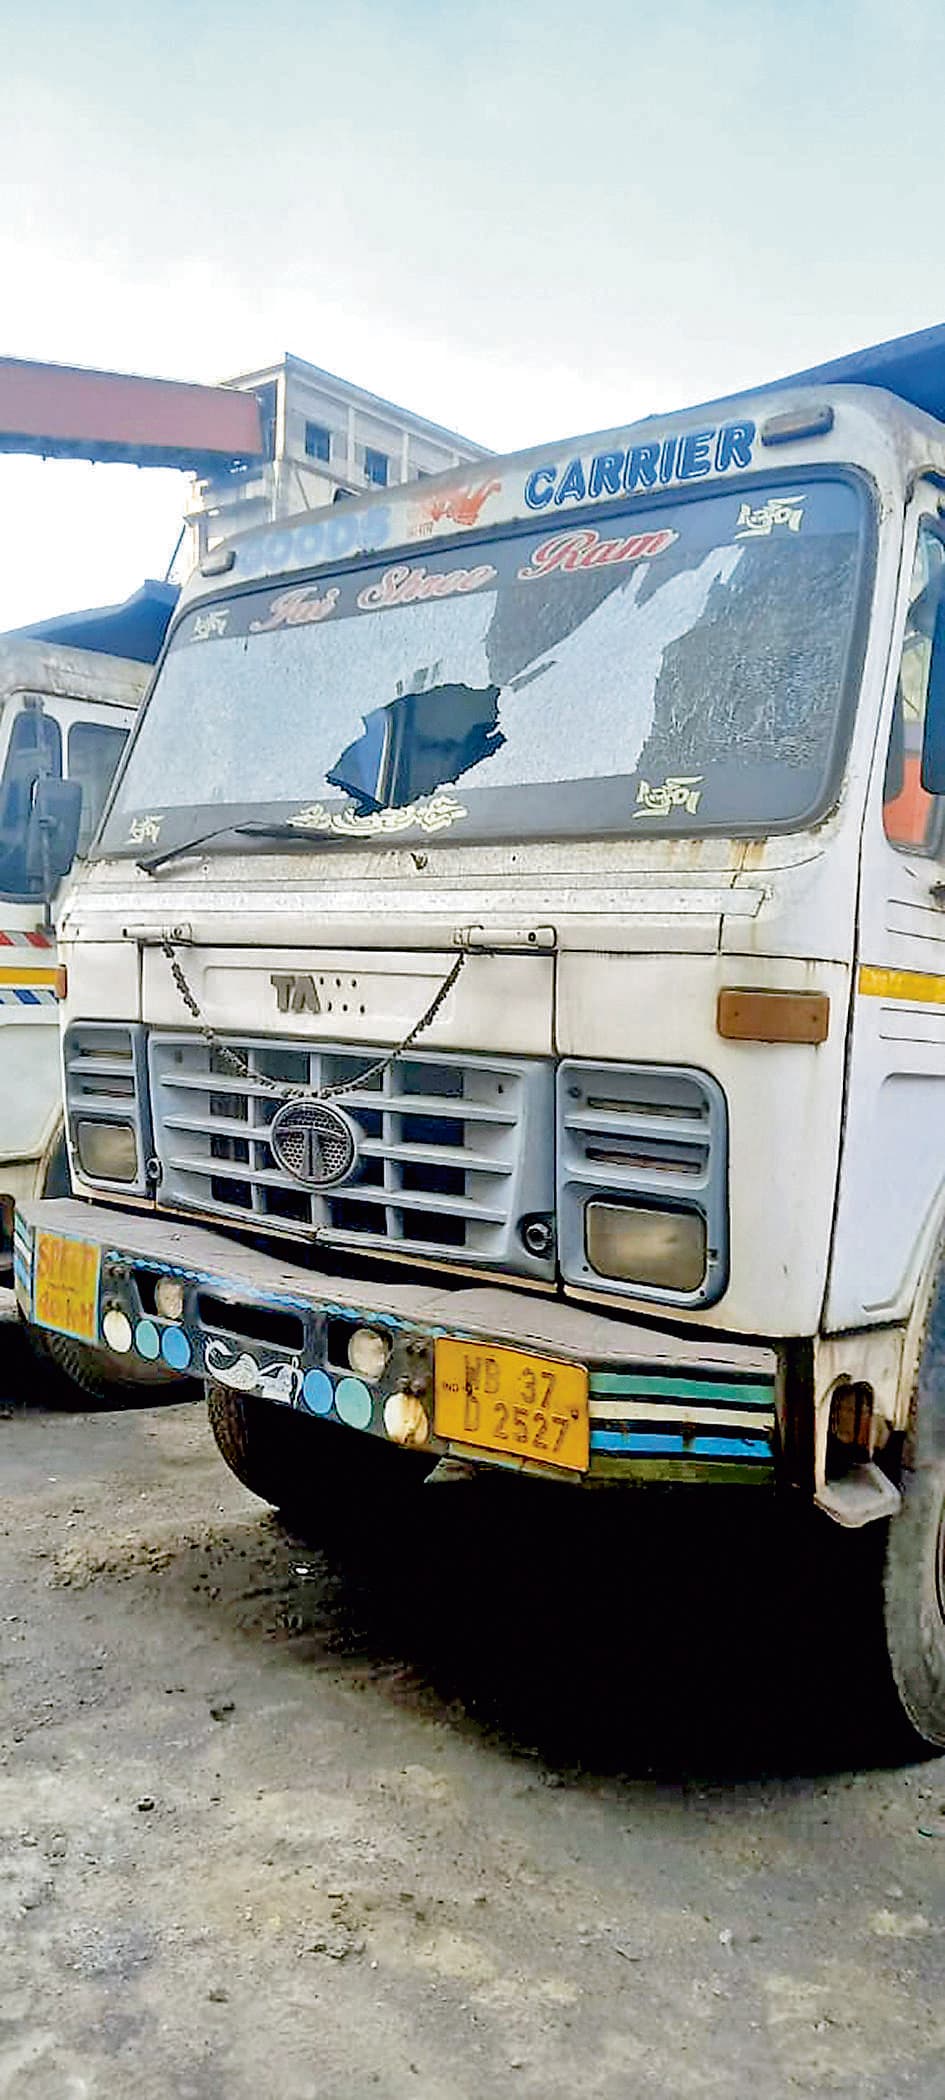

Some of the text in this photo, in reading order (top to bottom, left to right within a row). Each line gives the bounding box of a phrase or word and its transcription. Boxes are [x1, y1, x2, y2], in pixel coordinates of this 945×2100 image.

[524, 418, 756, 510] CARRIER
[249, 529, 680, 633] Jai Shree Ram
[463, 1354, 557, 1409] WB 37
[463, 1393, 569, 1452] D 2527
